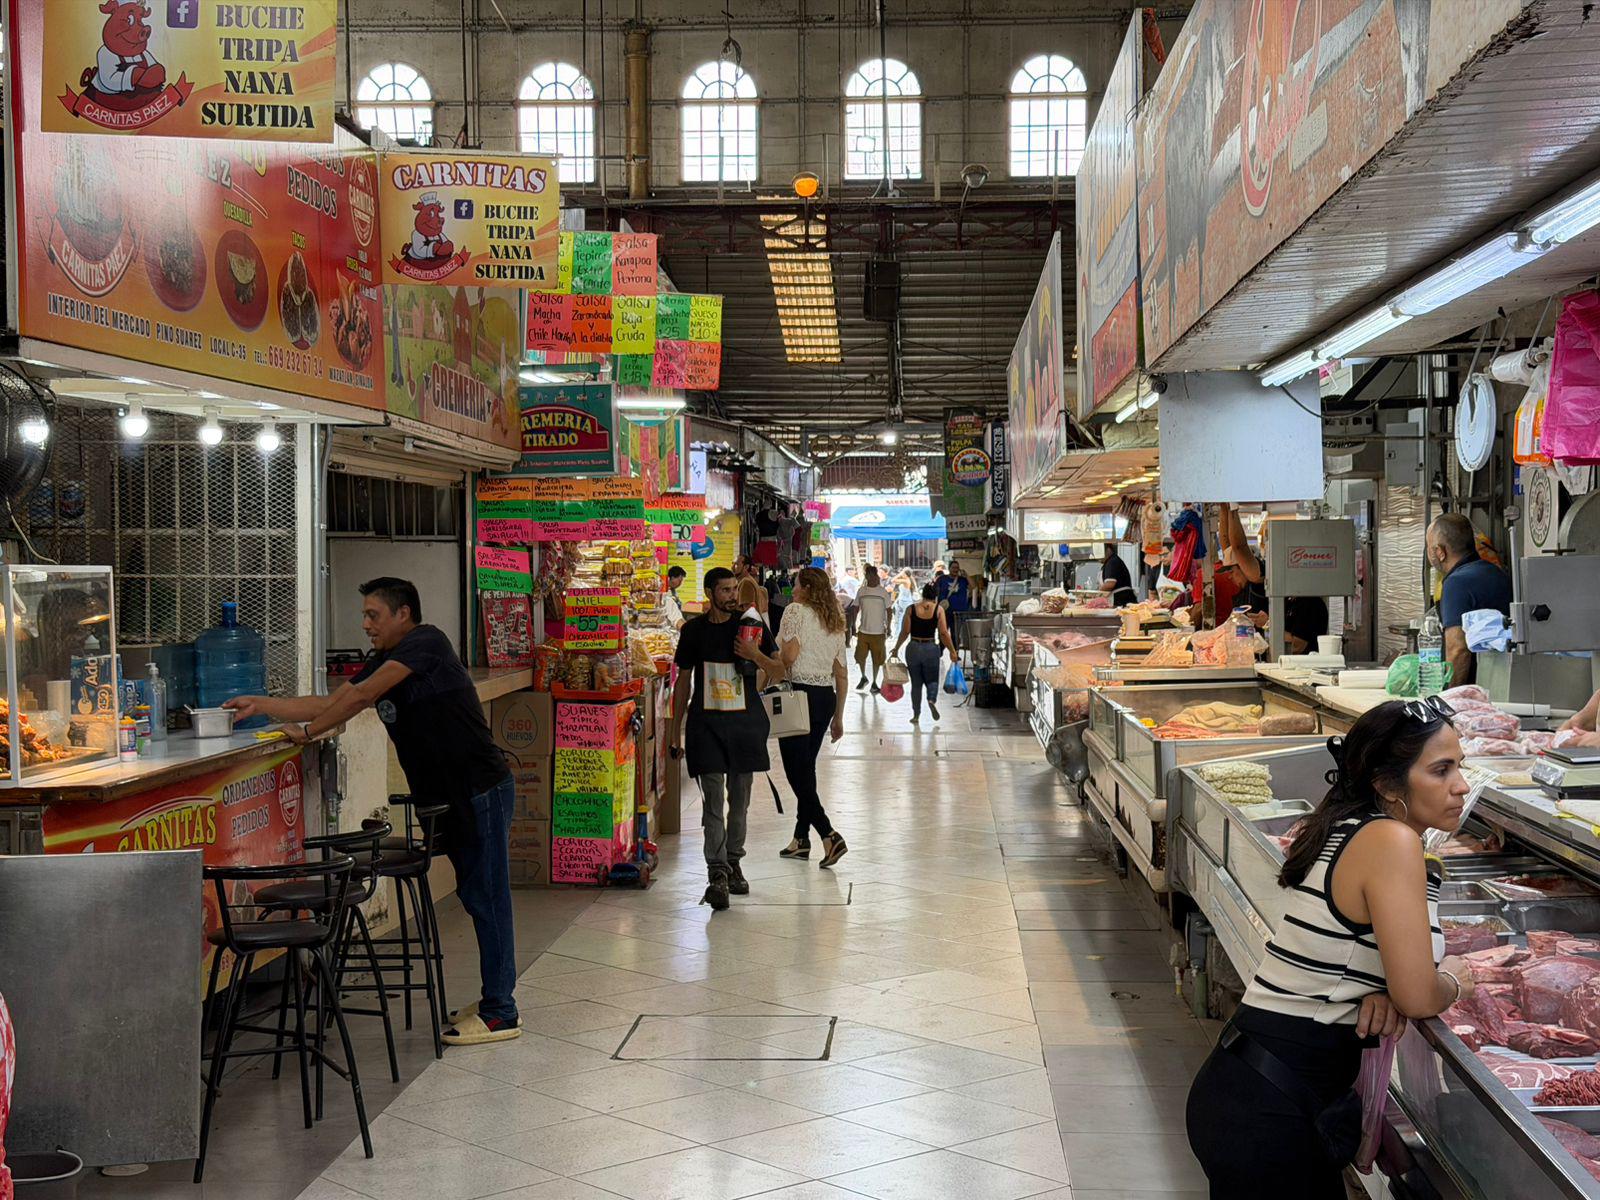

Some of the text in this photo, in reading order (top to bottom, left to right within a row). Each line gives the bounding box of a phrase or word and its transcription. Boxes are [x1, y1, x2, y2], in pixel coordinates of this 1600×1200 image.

[216, 5, 304, 30] BUCHE
[219, 37, 299, 63] TRIPA
[223, 70, 294, 95] NANA
[83, 94, 172, 125] CARNITAS PAEZ
[201, 102, 315, 128] SURTIDA
[393, 161, 547, 194] CARNITAS
[287, 164, 337, 219] PEDIDOS
[223, 201, 253, 228] QUESADILLA
[484, 204, 539, 221] BUCHE
[486, 225, 535, 241] TRIPA
[617, 235, 648, 249] Salsa
[489, 245, 532, 260] NANA
[61, 238, 127, 287] CARNITAS PAEZ
[404, 266, 439, 280] CARNITAS
[475, 264, 545, 280] SURTIDA
[532, 288, 564, 306] Salsa
[576, 291, 607, 307] Salsa
[617, 293, 650, 309] Salsa
[534, 307, 561, 320] Macha
[48, 292, 248, 360] INTERIOR DEL MERCADO PINO SUAREZ LOCAL C-35
[528, 328, 549, 342] Chile
[581, 331, 589, 344] la
[616, 327, 645, 343] Cruda
[268, 344, 284, 370] 669
[286, 349, 300, 372] 232
[301, 354, 313, 376] 67
[313, 358, 323, 379] 34
[523, 432, 579, 448] TIRADO
[669, 511, 699, 523] HUEVO
[949, 520, 965, 529] 115
[970, 519, 986, 528] 110
[576, 596, 604, 606] MIEL
[559, 704, 609, 718] SUAVES
[507, 719, 532, 732] 360
[560, 725, 609, 734] MAZATLAN
[222, 769, 276, 807] ORDENE SUS
[231, 805, 270, 840] PEDIDOS
[557, 837, 598, 849] CORICOS
